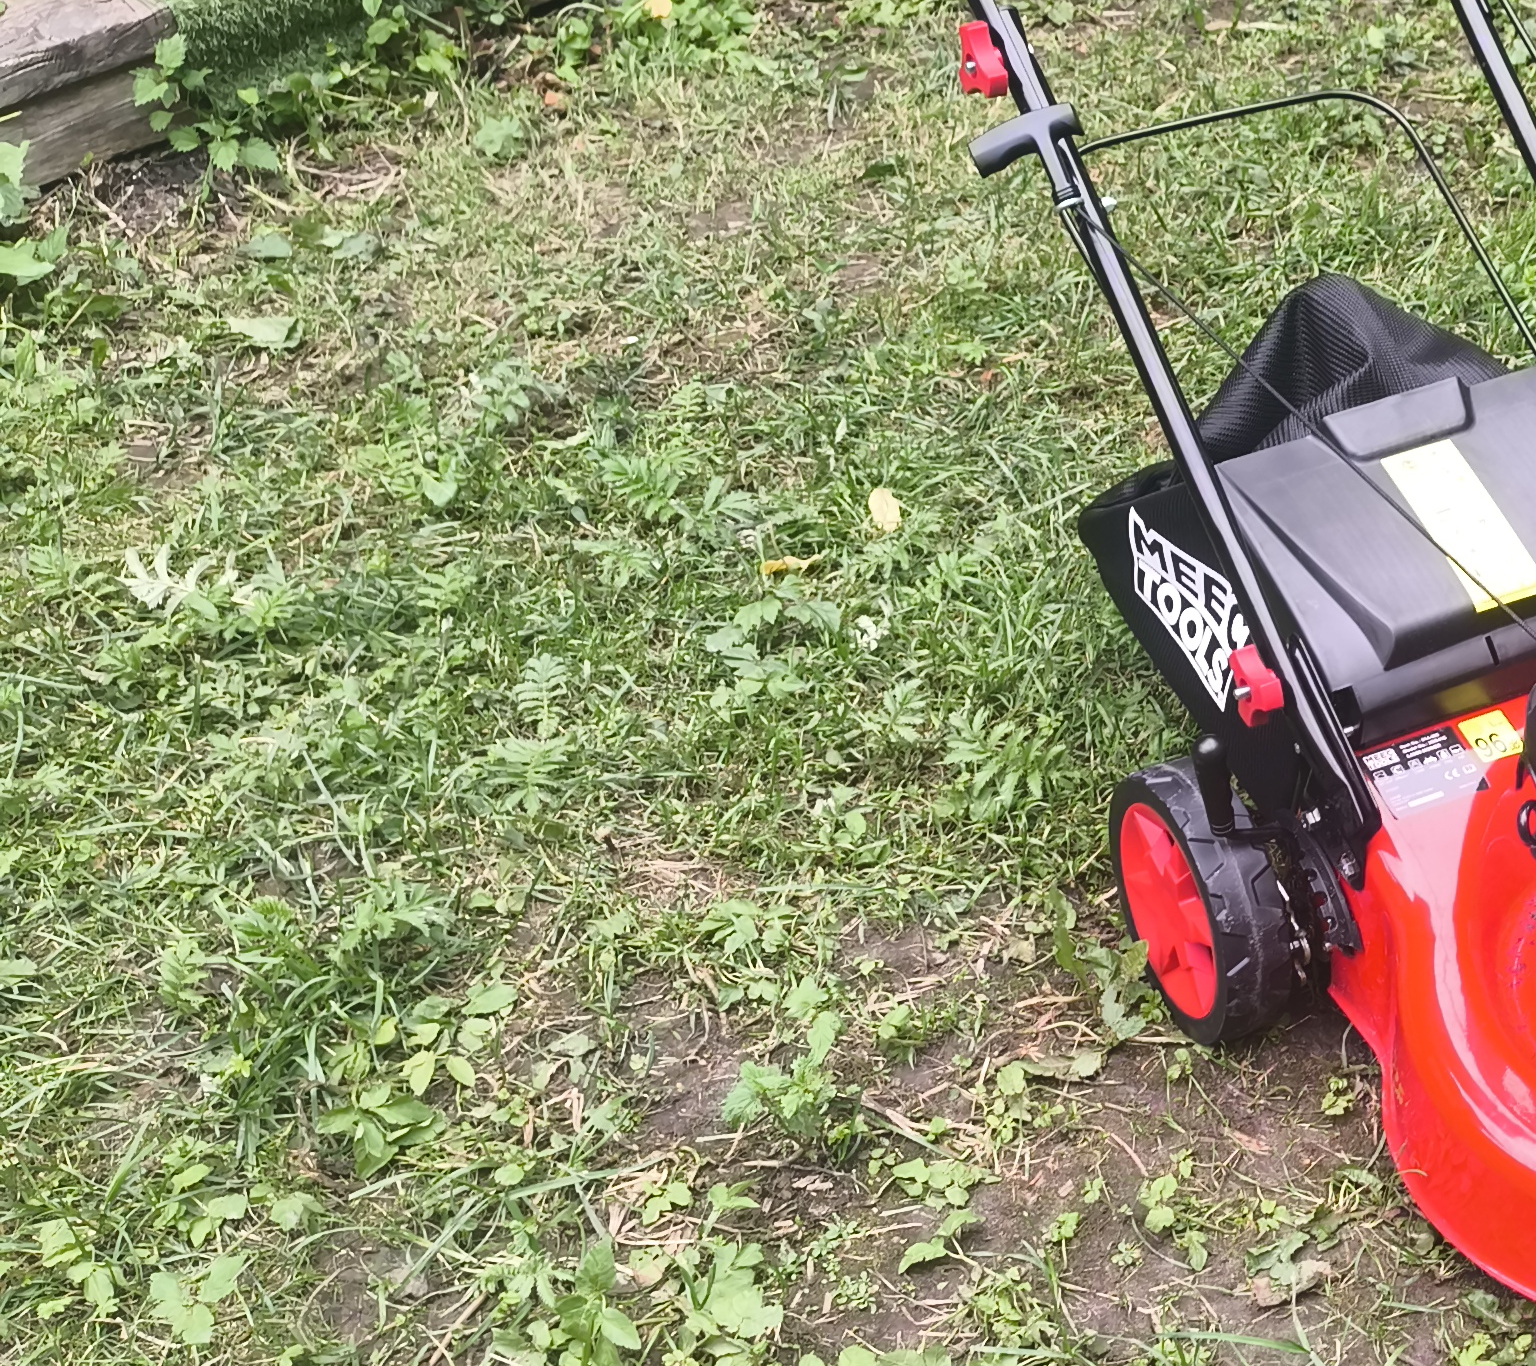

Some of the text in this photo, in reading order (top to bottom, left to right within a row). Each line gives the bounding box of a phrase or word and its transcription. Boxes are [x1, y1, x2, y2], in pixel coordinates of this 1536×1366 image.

[1130, 511, 1250, 650] MEEC
[1138, 561, 1229, 686] TOOLS
[1475, 733, 1507, 757] 96
